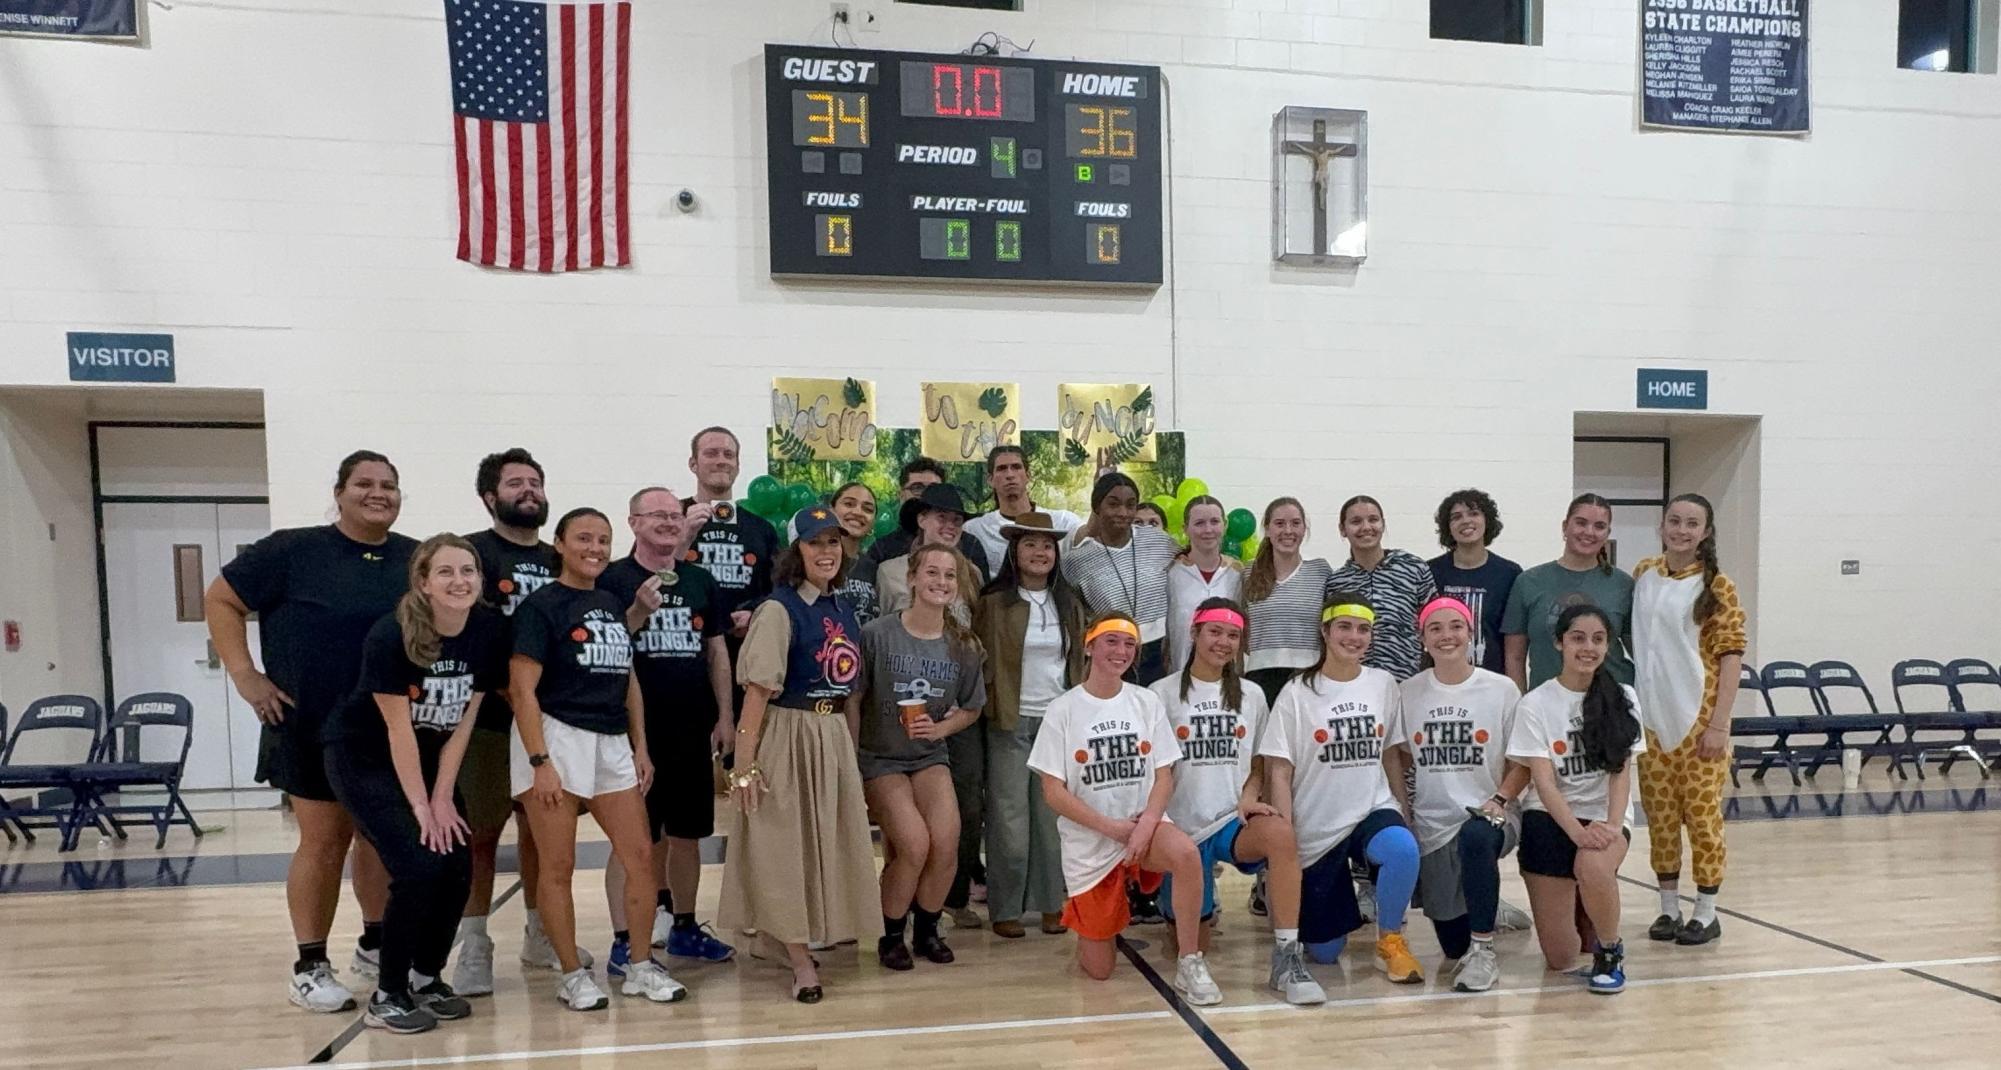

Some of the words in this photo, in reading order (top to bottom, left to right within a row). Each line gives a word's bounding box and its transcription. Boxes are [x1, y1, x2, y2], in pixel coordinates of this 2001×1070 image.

[1692, 0, 1800, 17] BASKETBALL
[1644, 11, 1701, 31] STATE
[1705, 15, 1801, 37] CHAMPIONS
[1645, 42, 1674, 51] LAUREN
[1646, 61, 1667, 70] KELLY
[1668, 62, 1701, 72] JACKSON
[1681, 54, 1701, 63] HILLS
[783, 57, 875, 84] GUEST
[1645, 70, 1677, 79] MEGHAN
[1730, 76, 1752, 84] ERIKA
[1765, 68, 1787, 77] SCOTT
[1062, 73, 1139, 97] HOME
[1646, 88, 1676, 98] MELISSA
[1730, 94, 1755, 103] LAURA
[806, 92, 868, 145] 34
[1711, 104, 1734, 114] CRAIG
[1750, 116, 1773, 125] ALLEN
[1079, 107, 1137, 159] 36
[898, 144, 978, 166] PERIOD
[991, 140, 1017, 177] 4
[806, 192, 860, 208] FOULS
[913, 195, 1027, 214] PLAYER-FOUL
[1077, 202, 1129, 218] FOULS
[828, 215, 852, 256] 0
[946, 218, 970, 259] 0
[996, 220, 1021, 262] 0
[1098, 225, 1121, 264] 0
[73, 347, 170, 367] VISITOR
[1648, 381, 1697, 397] HOME
[702, 530, 726, 541] THIS
[728, 532, 739, 542] IS
[698, 542, 745, 565] THE
[514, 562, 538, 573] THIS
[673, 595, 684, 606] IS
[648, 607, 693, 631] THE
[636, 629, 702, 652] JUNGLE
[576, 643, 633, 667] JUNGL
[430, 660, 456, 675] THIS
[885, 653, 915, 674] HOLY
[920, 658, 961, 681] NAMES
[423, 674, 475, 706] THE
[36, 705, 86, 719] JAGUARS
[129, 702, 177, 716] JAGUARS
[1194, 700, 1219, 713] THIS
[1331, 702, 1356, 715] THIS
[1358, 703, 1369, 714] IS
[1429, 706, 1454, 719] THIS
[1457, 707, 1469, 719] IS
[1091, 720, 1117, 734] THIS
[1120, 720, 1131, 731] IS
[1190, 714, 1238, 739] THE
[1328, 714, 1377, 742] THE
[1423, 720, 1475, 745] THE
[1087, 732, 1140, 762] THE
[1181, 739, 1240, 761] JUNGL
[1318, 740, 1382, 763] JUNGL
